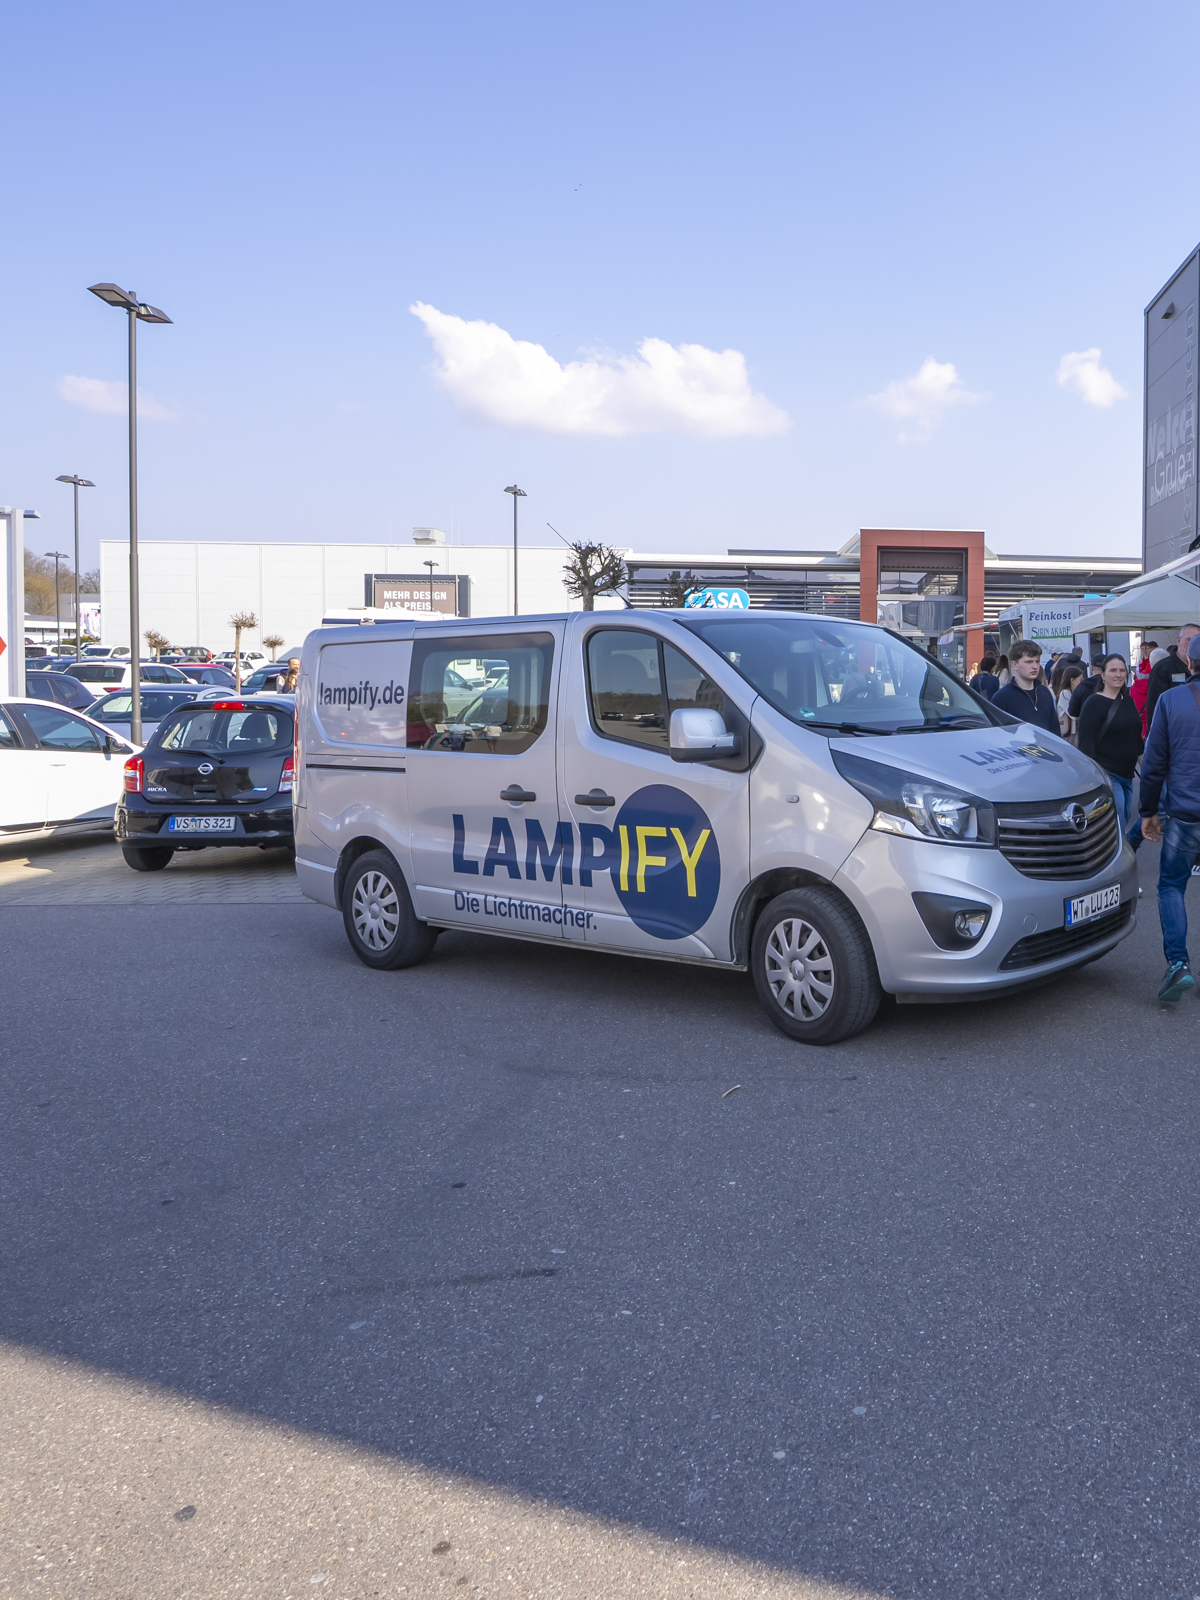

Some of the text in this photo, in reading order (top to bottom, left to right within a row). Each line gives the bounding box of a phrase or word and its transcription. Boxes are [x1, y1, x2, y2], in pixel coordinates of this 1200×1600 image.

[384, 591, 447, 600] MEHR DESIGN
[688, 592, 744, 608] CASA
[1029, 611, 1072, 621] Feinkost
[319, 680, 404, 711] lampify.de
[176, 818, 231, 828] VS TS 321
[452, 813, 711, 898] LAMPIFY
[454, 890, 598, 931] Die Lichtmacher.
[1072, 886, 1120, 920] WT LU 123
